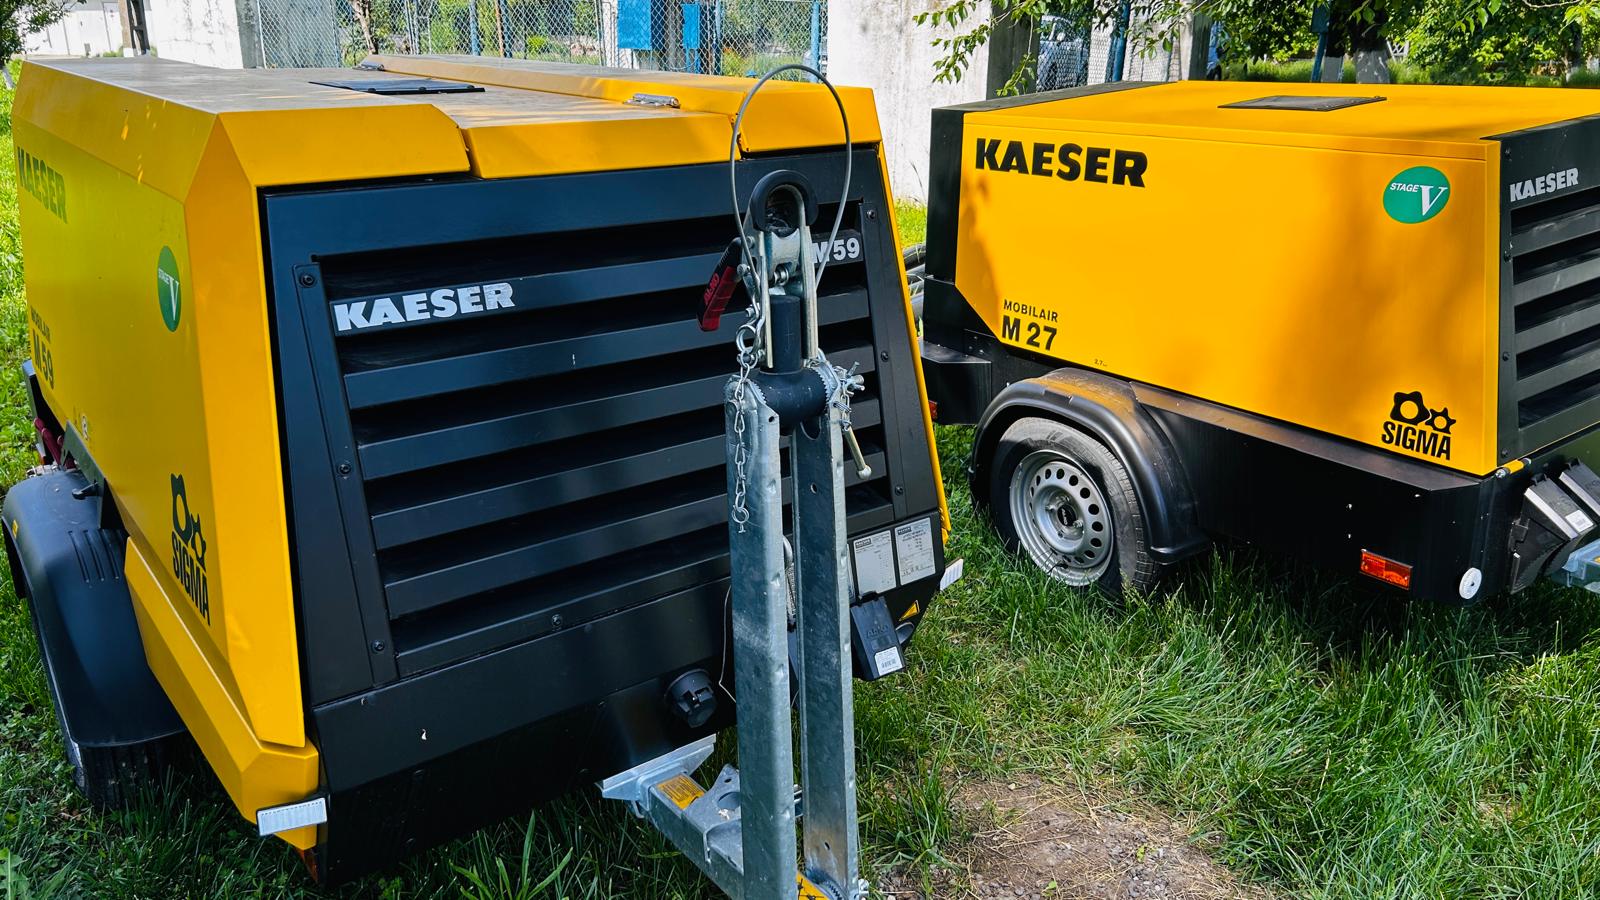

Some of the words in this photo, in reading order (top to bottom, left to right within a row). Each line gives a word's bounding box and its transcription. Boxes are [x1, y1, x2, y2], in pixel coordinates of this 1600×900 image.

[975, 137, 1148, 188] KAESER
[1509, 167, 1579, 202] KAESER
[17, 145, 68, 225] KAESER
[1390, 182, 1420, 193] STAGE
[1420, 184, 1448, 216] V
[811, 241, 830, 264] M
[833, 237, 860, 261] 59
[169, 274, 180, 321] V
[333, 282, 515, 331] KAESER
[1003, 299, 1058, 323] MOBILAIR
[1002, 315, 1021, 342] M
[1026, 321, 1057, 351] 27
[33, 328, 42, 373] M
[41, 341, 54, 390] 59
[1381, 420, 1451, 461] SIGMA
[171, 530, 211, 627] SIGMA
